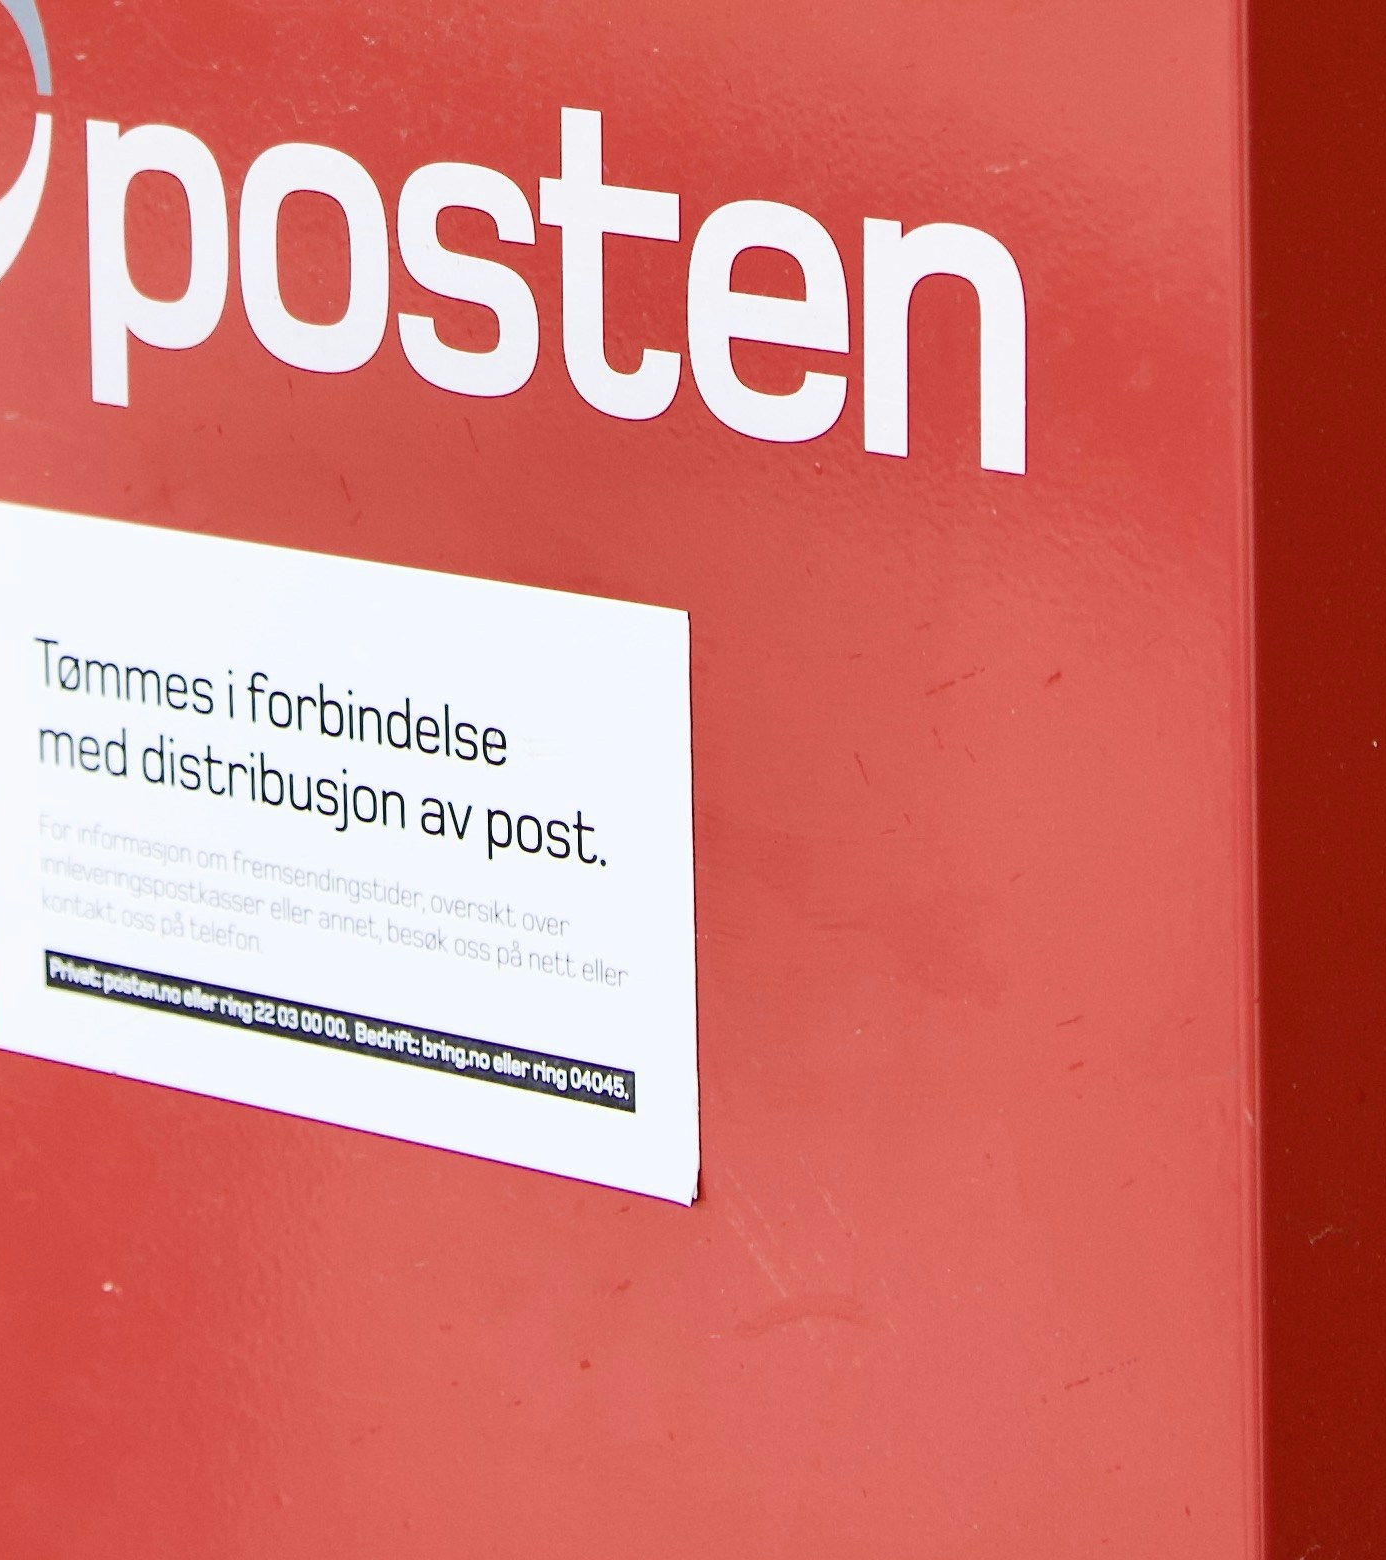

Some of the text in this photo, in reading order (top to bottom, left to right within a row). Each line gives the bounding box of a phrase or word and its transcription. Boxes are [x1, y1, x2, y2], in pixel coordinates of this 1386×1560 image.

[85, 107, 1027, 475] posten
[34, 637, 507, 766] Tømmes i forbindelse
[39, 727, 607, 867] med distribusjon av post.
[39, 814, 571, 937] For informasjon om fremsendingstider, oversikt over
[40, 855, 629, 987] innleveringspostkasser eller annet, besøk oss på nett eller
[41, 886, 117, 925] kontakt
[121, 908, 156, 932] oss
[161, 911, 185, 939] på
[103, 973, 182, 1006] posten.no
[183, 986, 217, 1013] eller
[219, 993, 253, 1024] ring
[254, 1001, 277, 1026] 22
[277, 1005, 299, 1031] 03
[300, 1009, 323, 1036] 00
[324, 1013, 351, 1042] 00.
[354, 1020, 421, 1057] Bedrift:
[421, 1035, 491, 1071] bring.no
[493, 1051, 531, 1079] eller
[533, 1060, 568, 1092] ring
[569, 1067, 630, 1102] 04045.
